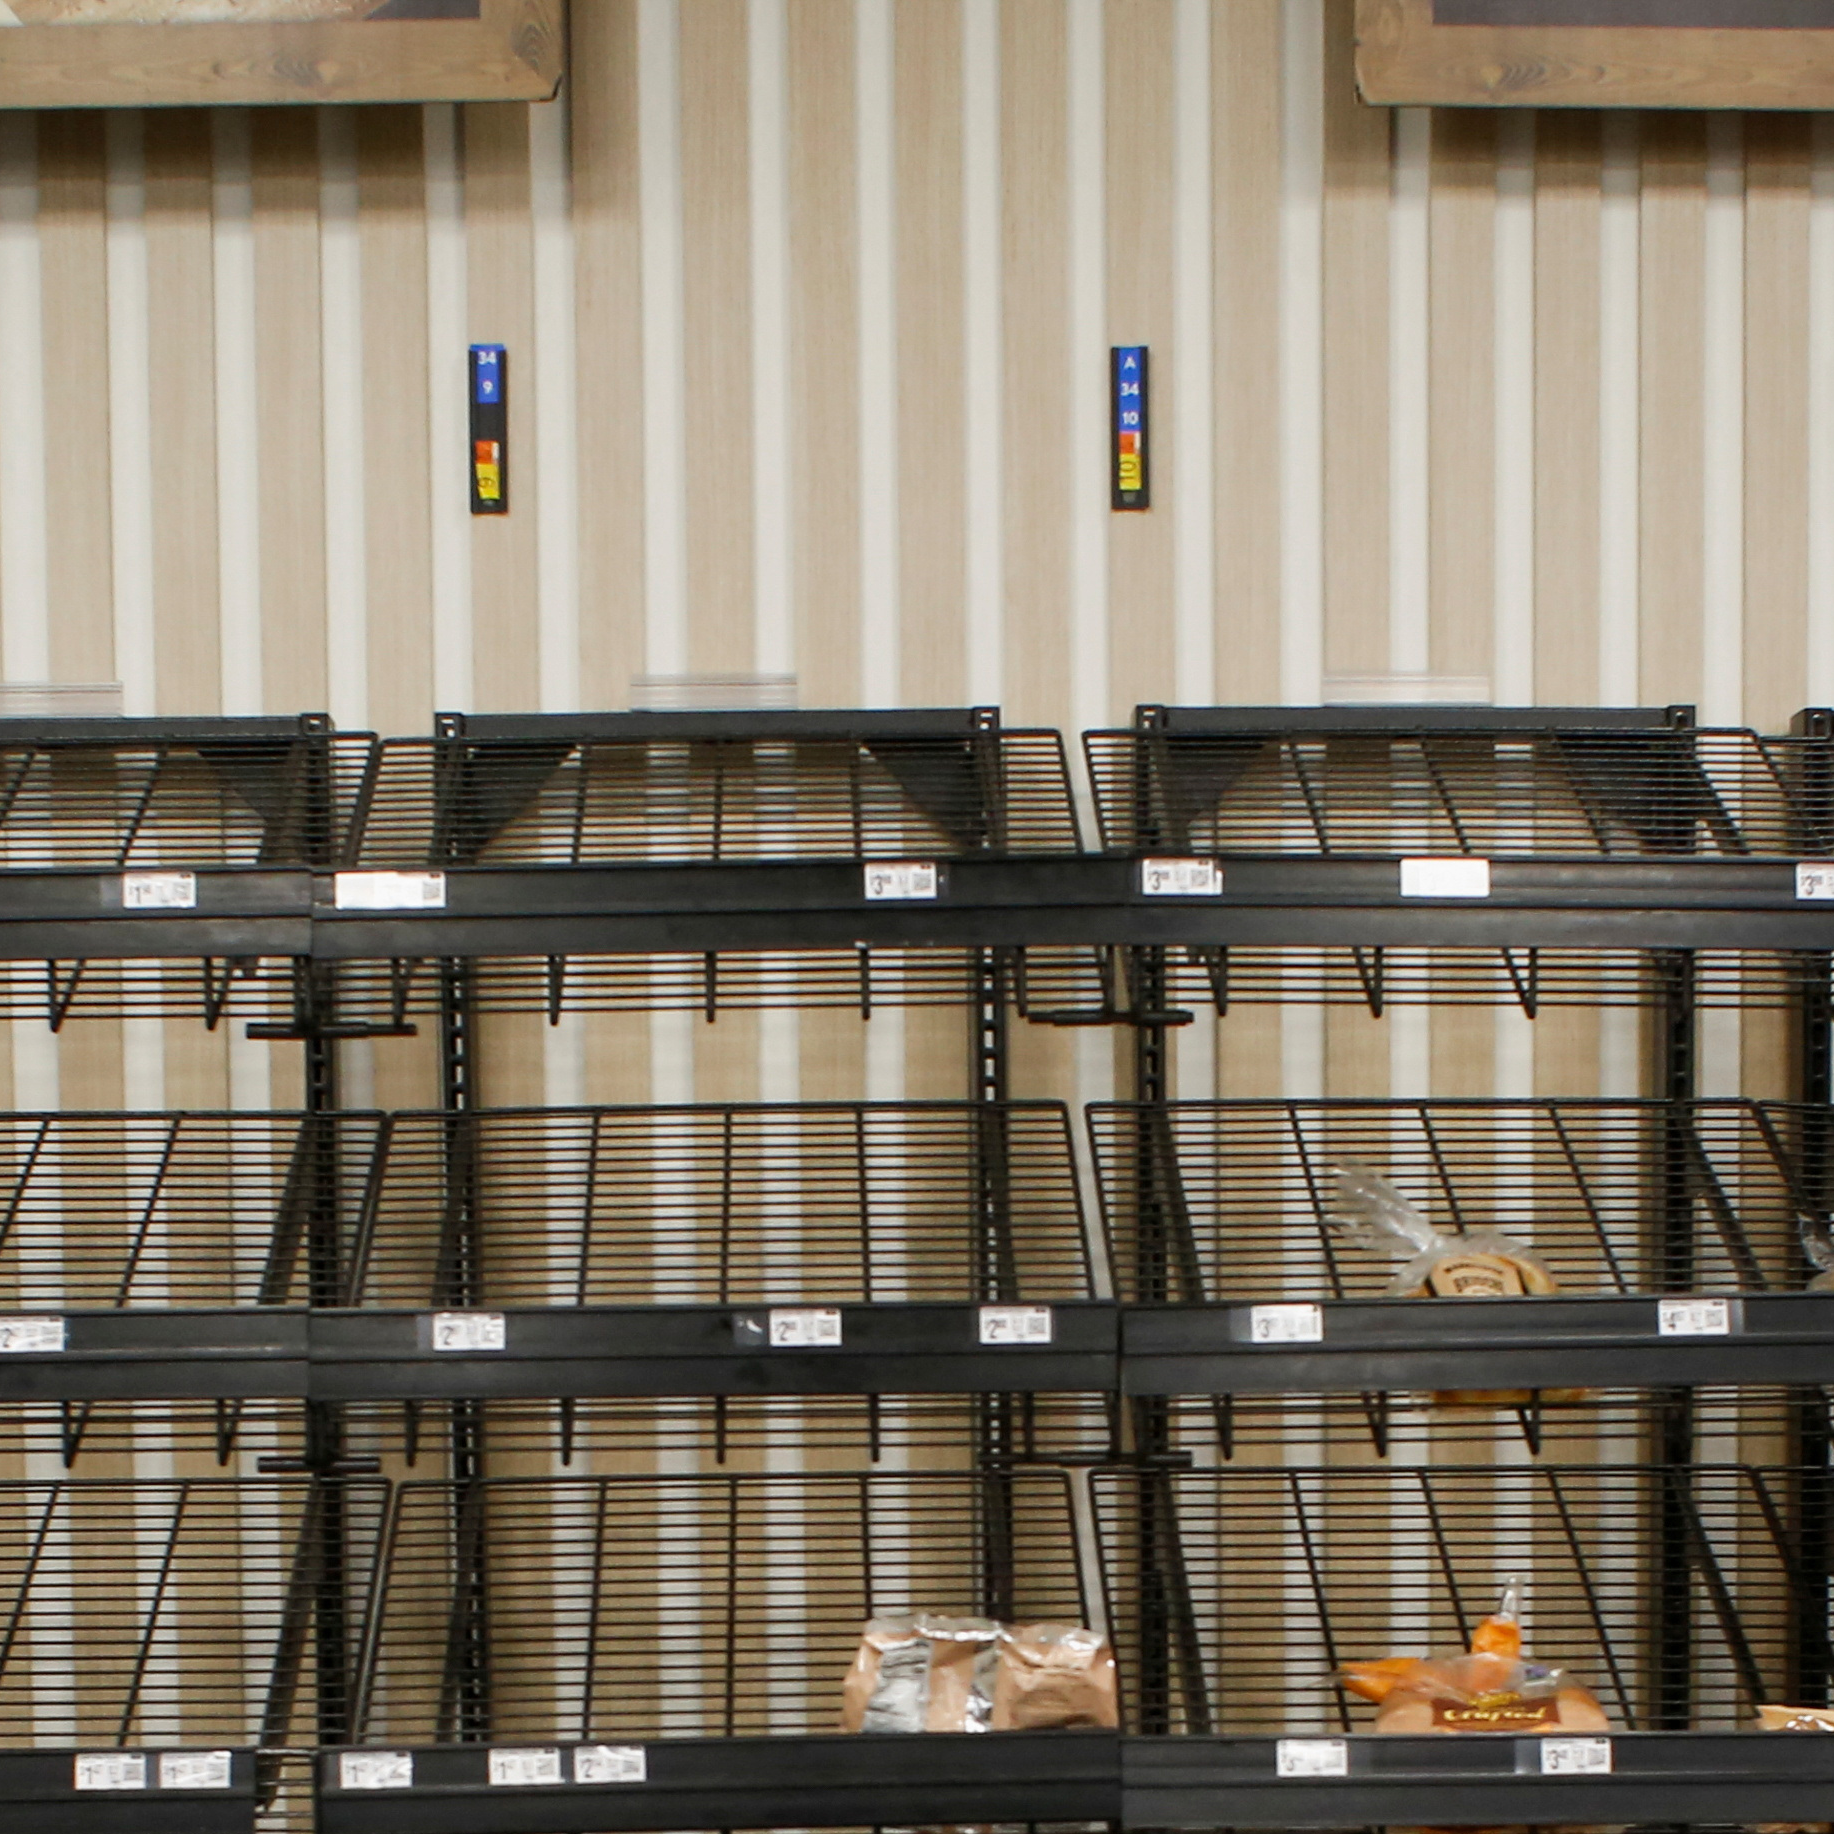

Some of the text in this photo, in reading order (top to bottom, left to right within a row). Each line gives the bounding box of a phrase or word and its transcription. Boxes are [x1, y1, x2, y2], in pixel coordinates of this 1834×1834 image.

[477, 351, 497, 366] 34
[1124, 356, 1136, 369] A
[482, 381, 493, 394] 9
[1120, 382, 1139, 397] 34
[1122, 411, 1139, 426] 10
